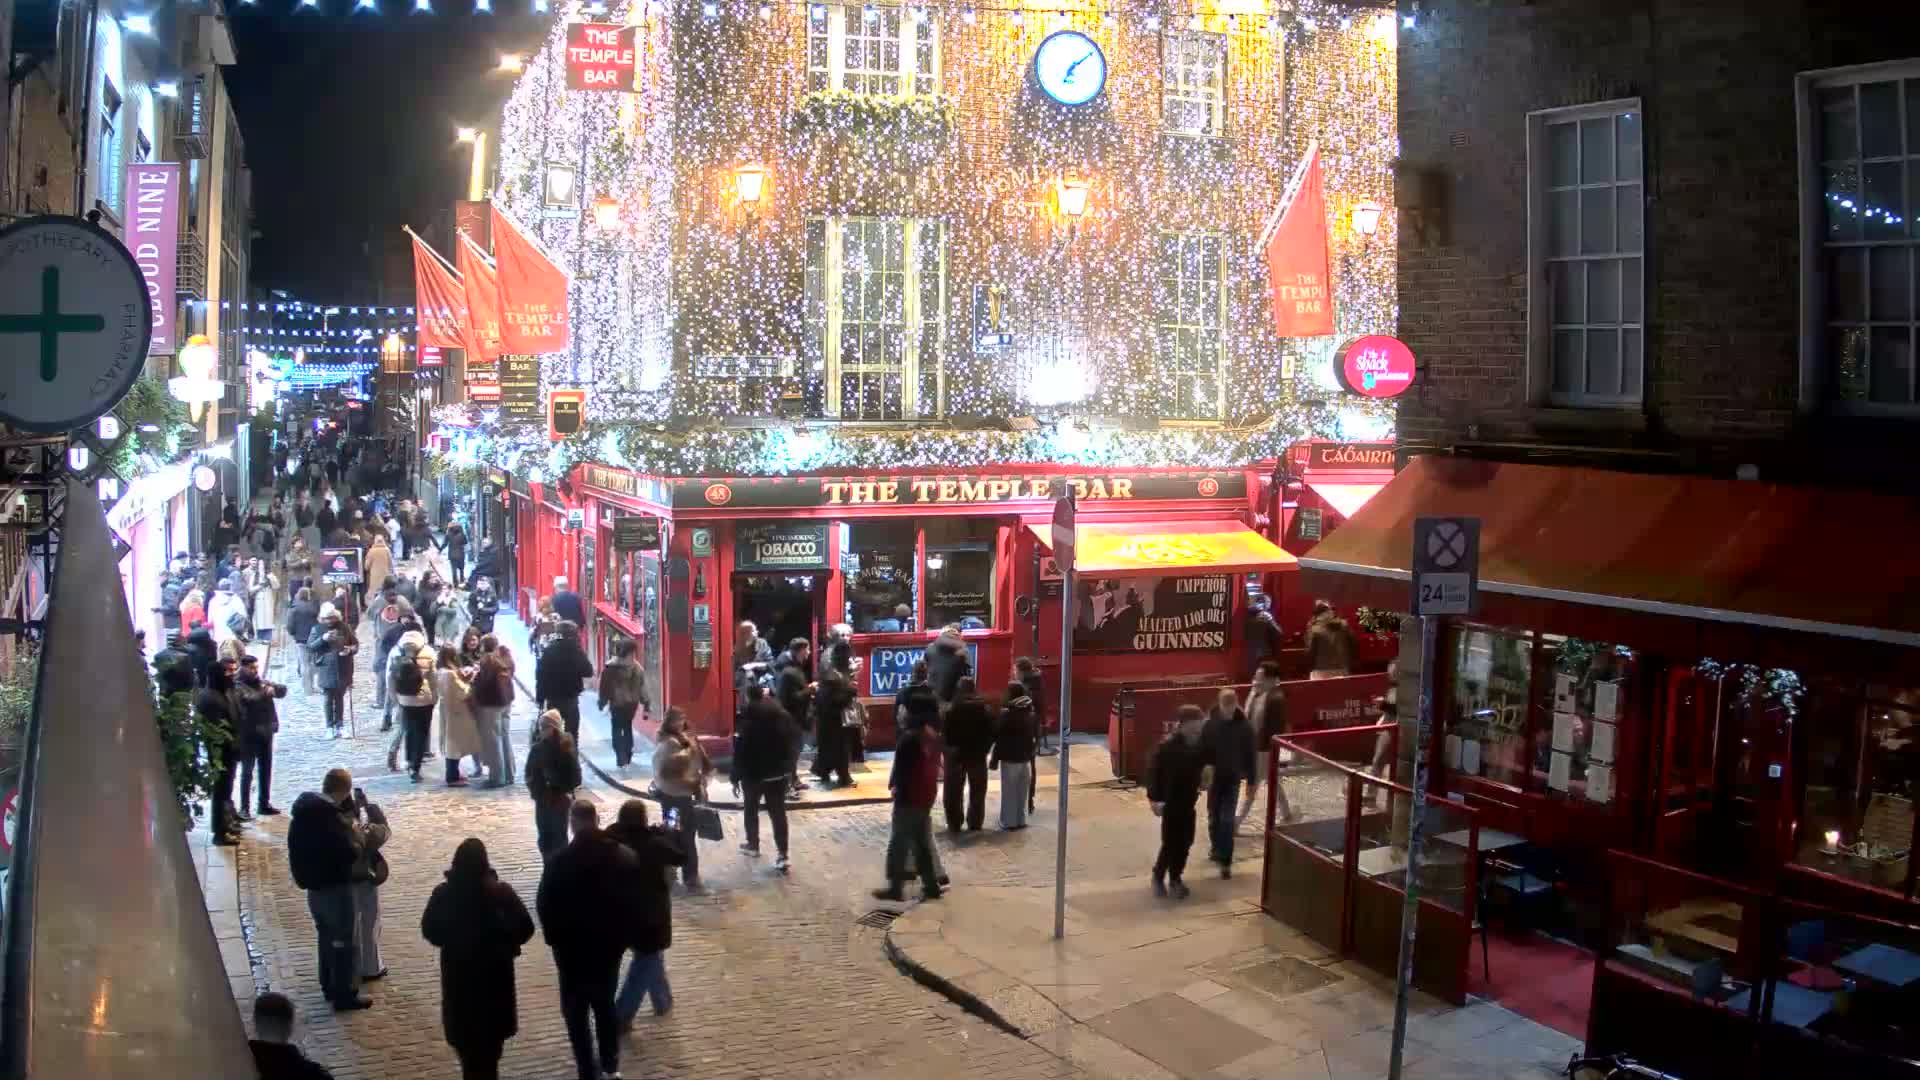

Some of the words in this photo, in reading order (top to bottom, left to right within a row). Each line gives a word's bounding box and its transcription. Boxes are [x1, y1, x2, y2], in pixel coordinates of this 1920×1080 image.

[585, 29, 618, 45] THE
[569, 47, 633, 64] TEMPLE
[583, 69, 618, 84] BAR
[136, 171, 169, 233] NINE
[1296, 273, 1318, 285] THE
[1279, 285, 1329, 299] TEMPL
[523, 303, 548, 313] THE
[1295, 301, 1322, 313] BAR
[504, 312, 565, 324] TEMPLE
[520, 325, 553, 337] BAR
[1356, 351, 1389, 374] Shack
[824, 481, 899, 504] THE
[913, 480, 1050, 502] TEMPLE
[1073, 478, 1133, 499] BAR
[750, 539, 817, 561] TOBACCO
[1176, 577, 1227, 594] EMPEROR
[1422, 584, 1443, 603] 24
[1212, 593, 1226, 608] OF
[1137, 615, 1182, 633] MALTED
[1184, 607, 1227, 632] LIQUORS
[1133, 631, 1225, 651] GUINNESS
[880, 649, 926, 668] POW
